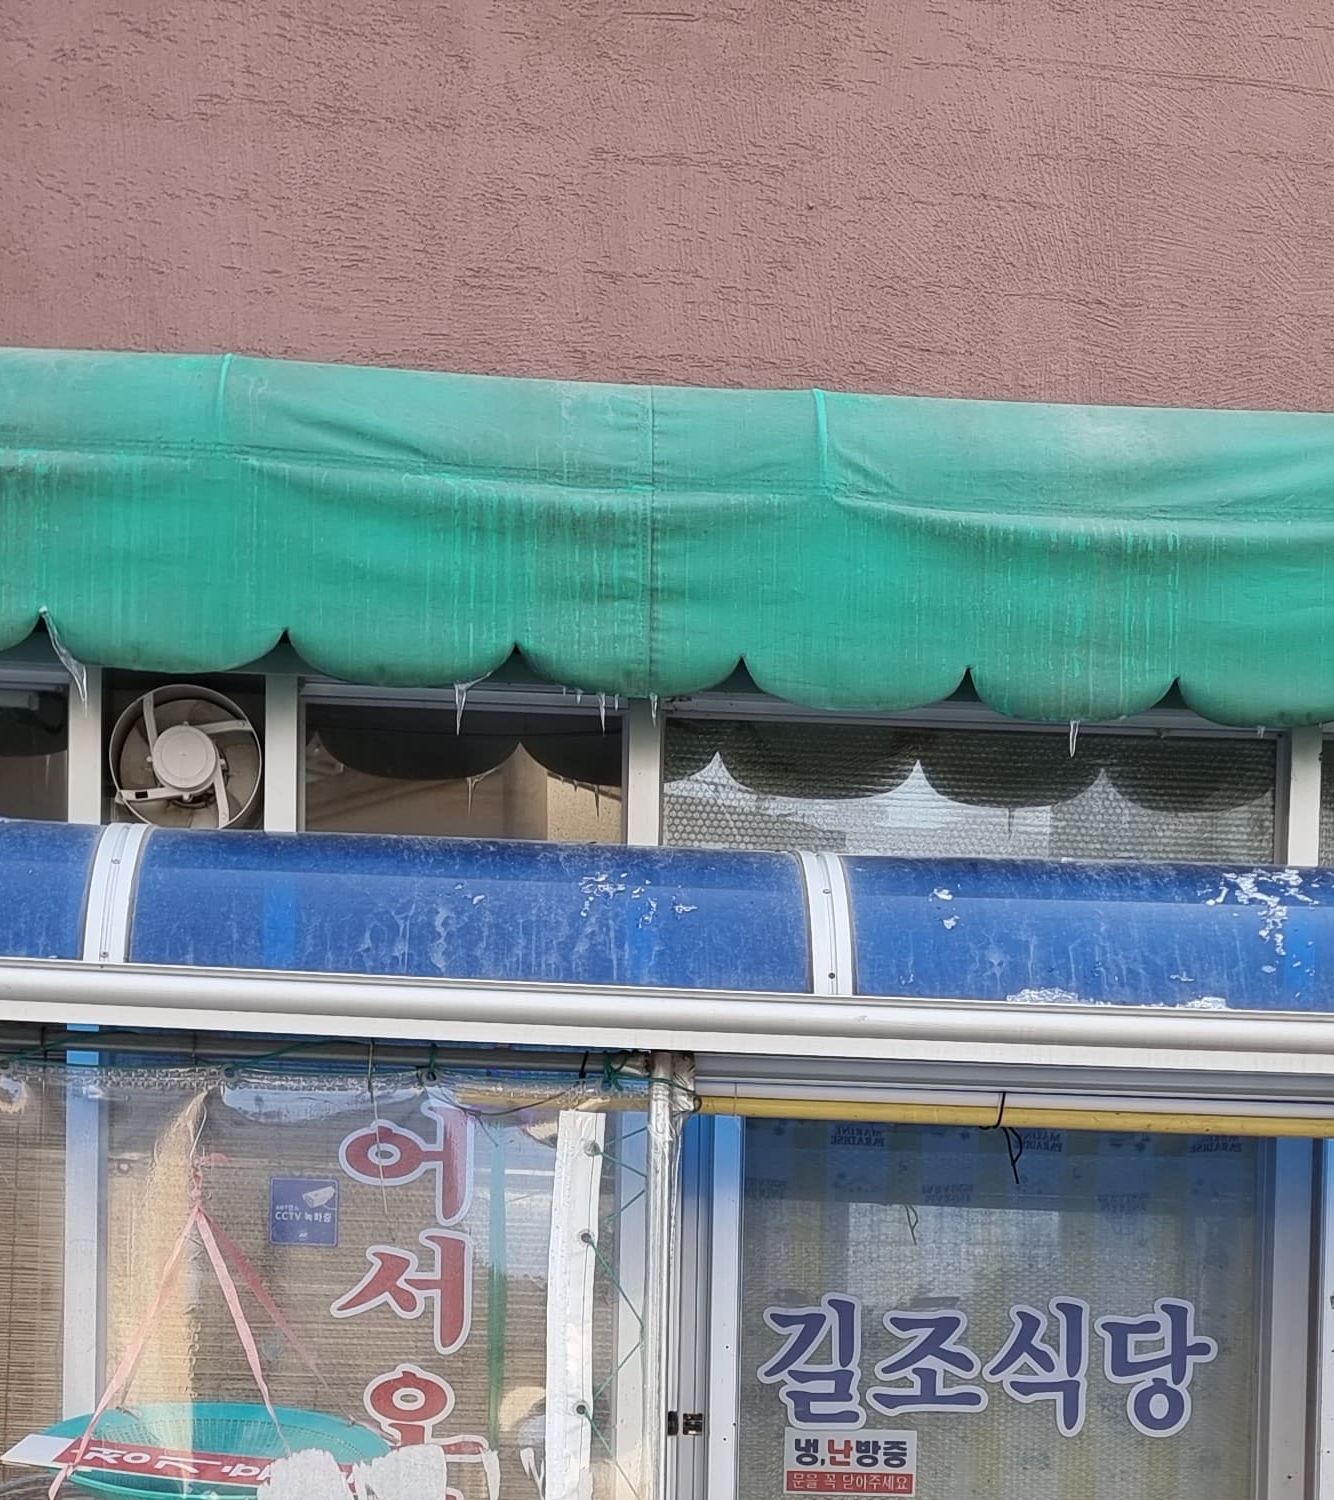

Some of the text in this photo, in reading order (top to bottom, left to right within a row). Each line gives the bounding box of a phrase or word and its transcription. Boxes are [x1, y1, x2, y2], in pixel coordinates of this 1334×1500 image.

[275, 1211, 302, 1221] CCTV
[758, 1293, 1218, 1437] 길조식당
[793, 1472, 818, 1489] 문을
[825, 1473, 836, 1489] 꼭
